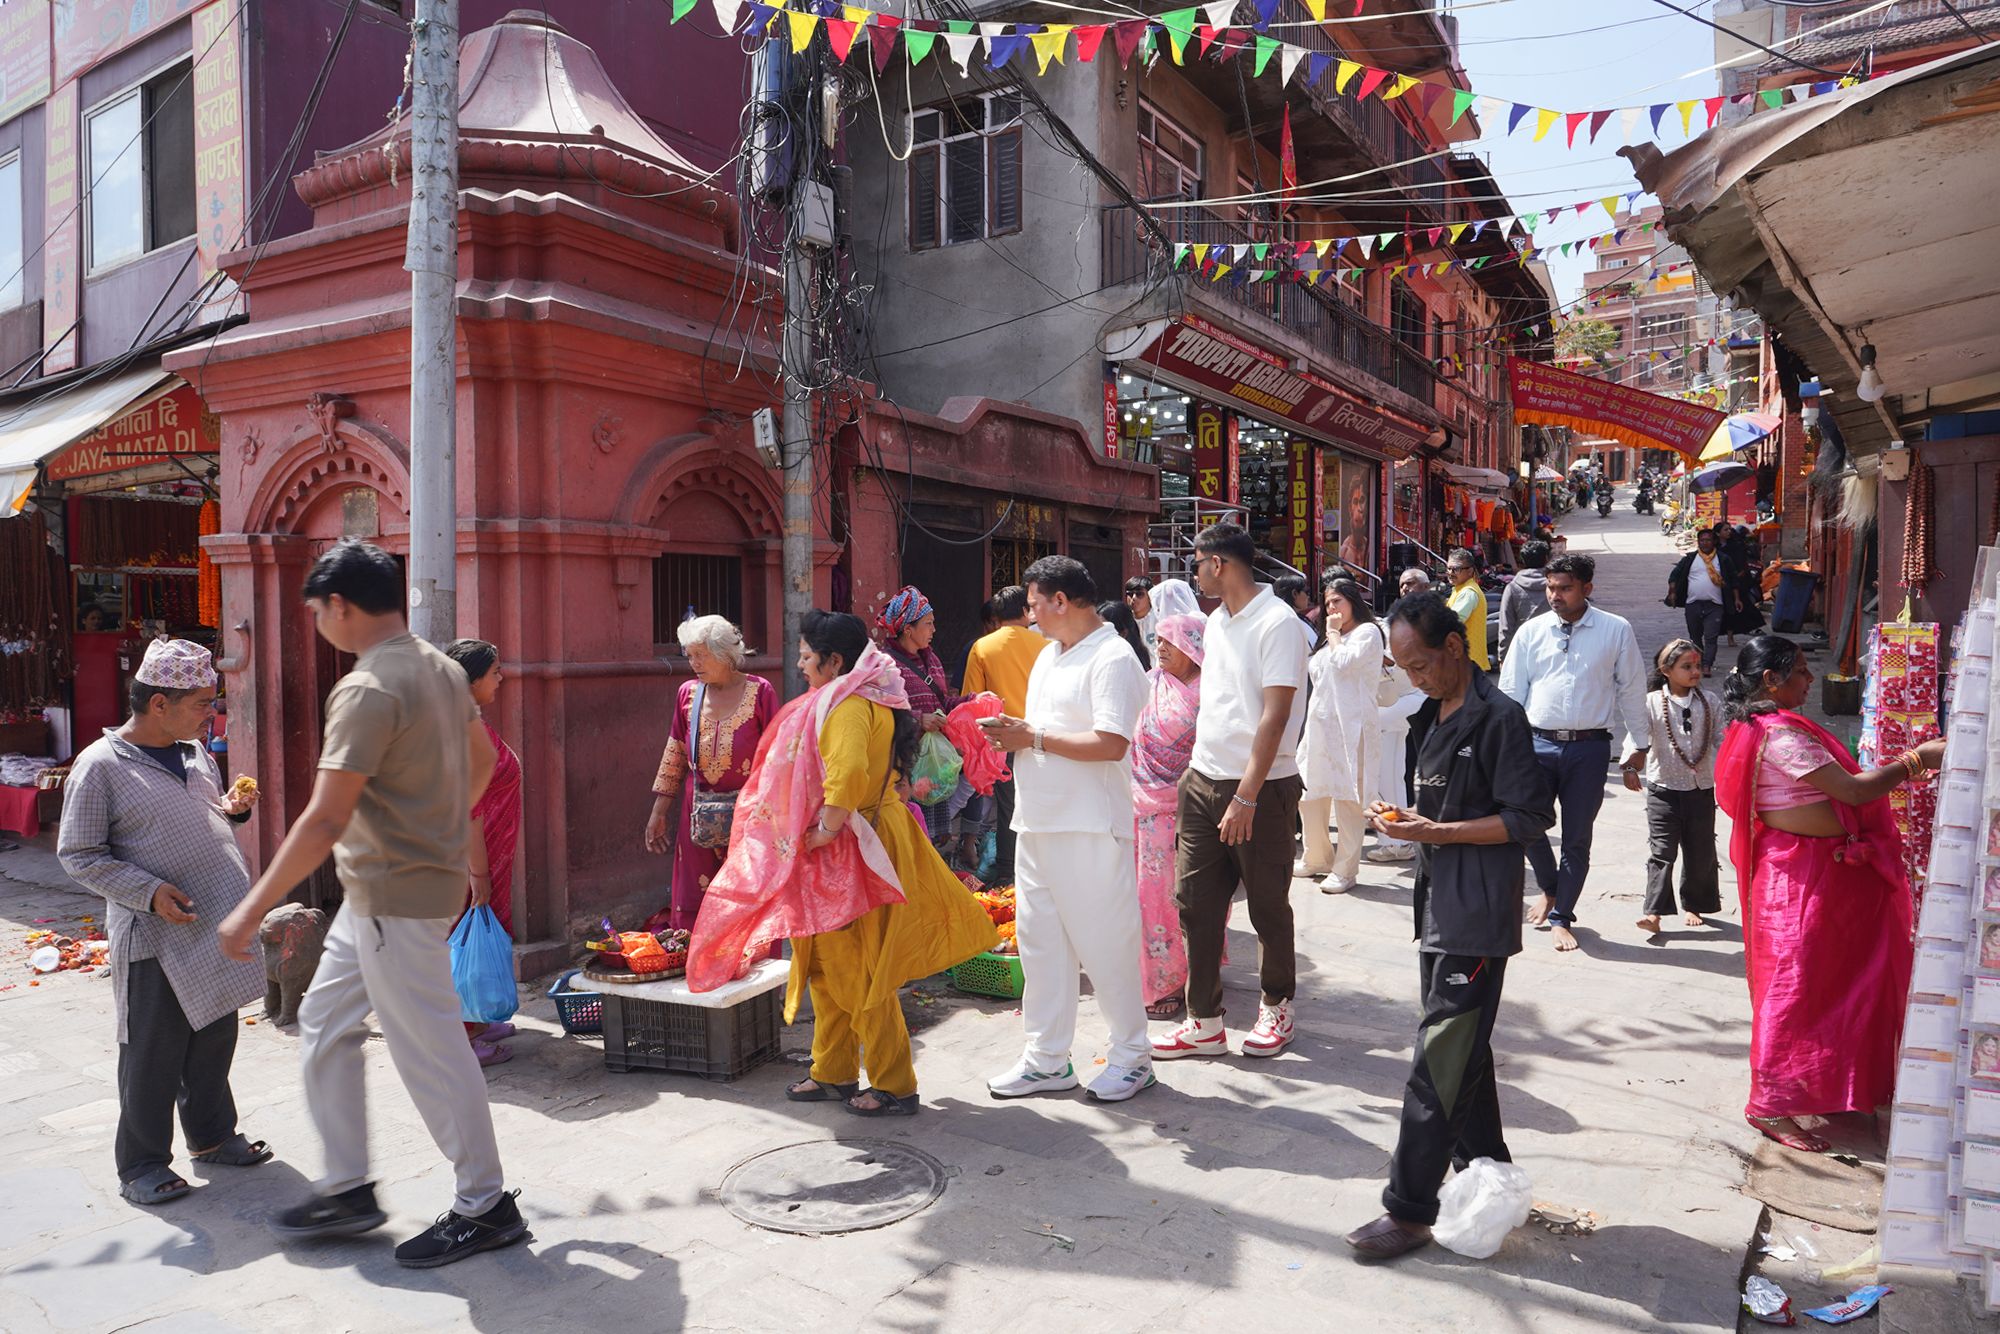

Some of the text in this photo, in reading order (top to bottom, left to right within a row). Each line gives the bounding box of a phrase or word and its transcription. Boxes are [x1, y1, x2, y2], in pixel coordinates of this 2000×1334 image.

[1166, 327, 1255, 380] TIRUPATI
[1240, 361, 1312, 406] AGRAWAL
[1229, 383, 1294, 416] RUDRAKSHA
[68, 427, 196, 474] JAYA MATA DI
